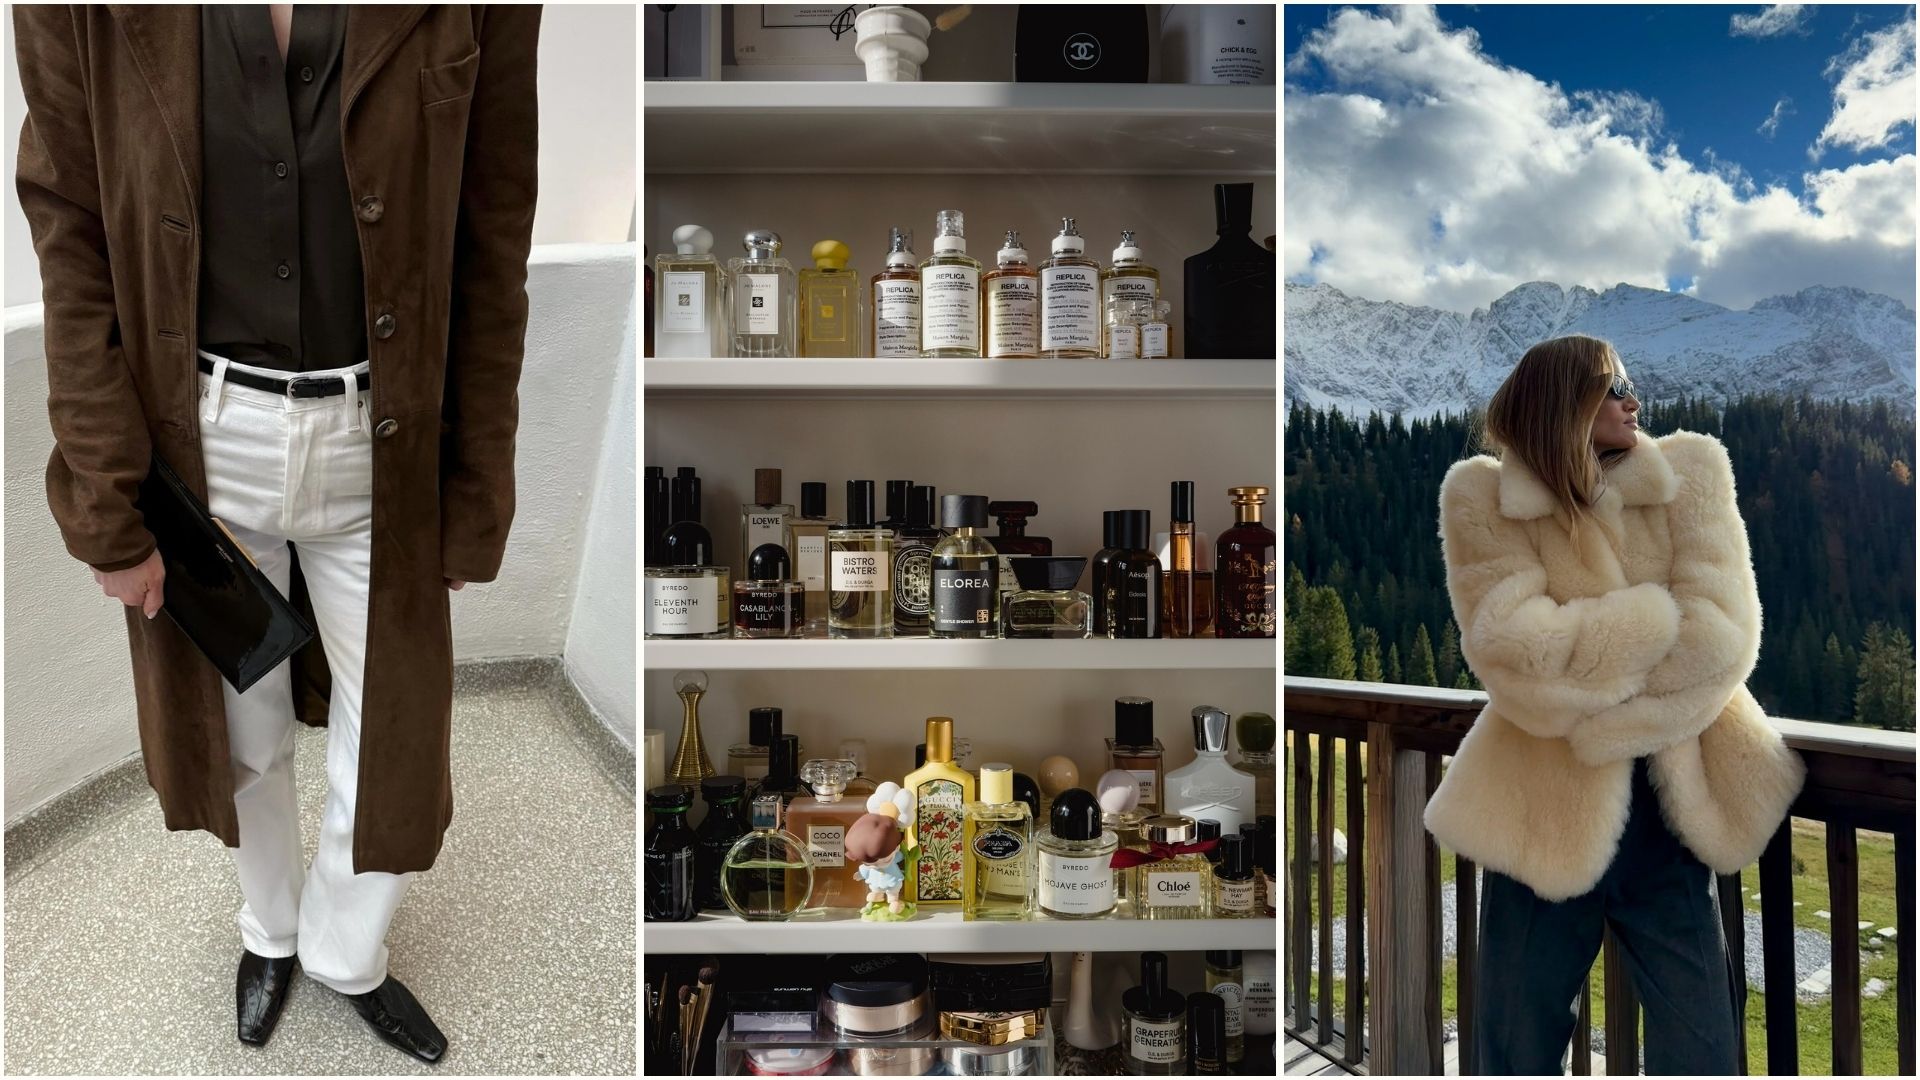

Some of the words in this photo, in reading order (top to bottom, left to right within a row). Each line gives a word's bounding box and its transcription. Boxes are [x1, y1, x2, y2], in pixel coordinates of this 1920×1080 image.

[752, 517, 781, 525] LOEWE
[843, 557, 875, 566] BISTRO
[842, 566, 878, 575] WATERS
[940, 578, 990, 588] ELOREA
[663, 607, 688, 615] HOUR
[755, 613, 773, 621] LILY
[813, 832, 841, 840] COCO
[1044, 878, 1078, 891] MOJAVE
[1080, 879, 1109, 891] GHOST
[1157, 880, 1191, 892] Chloé
